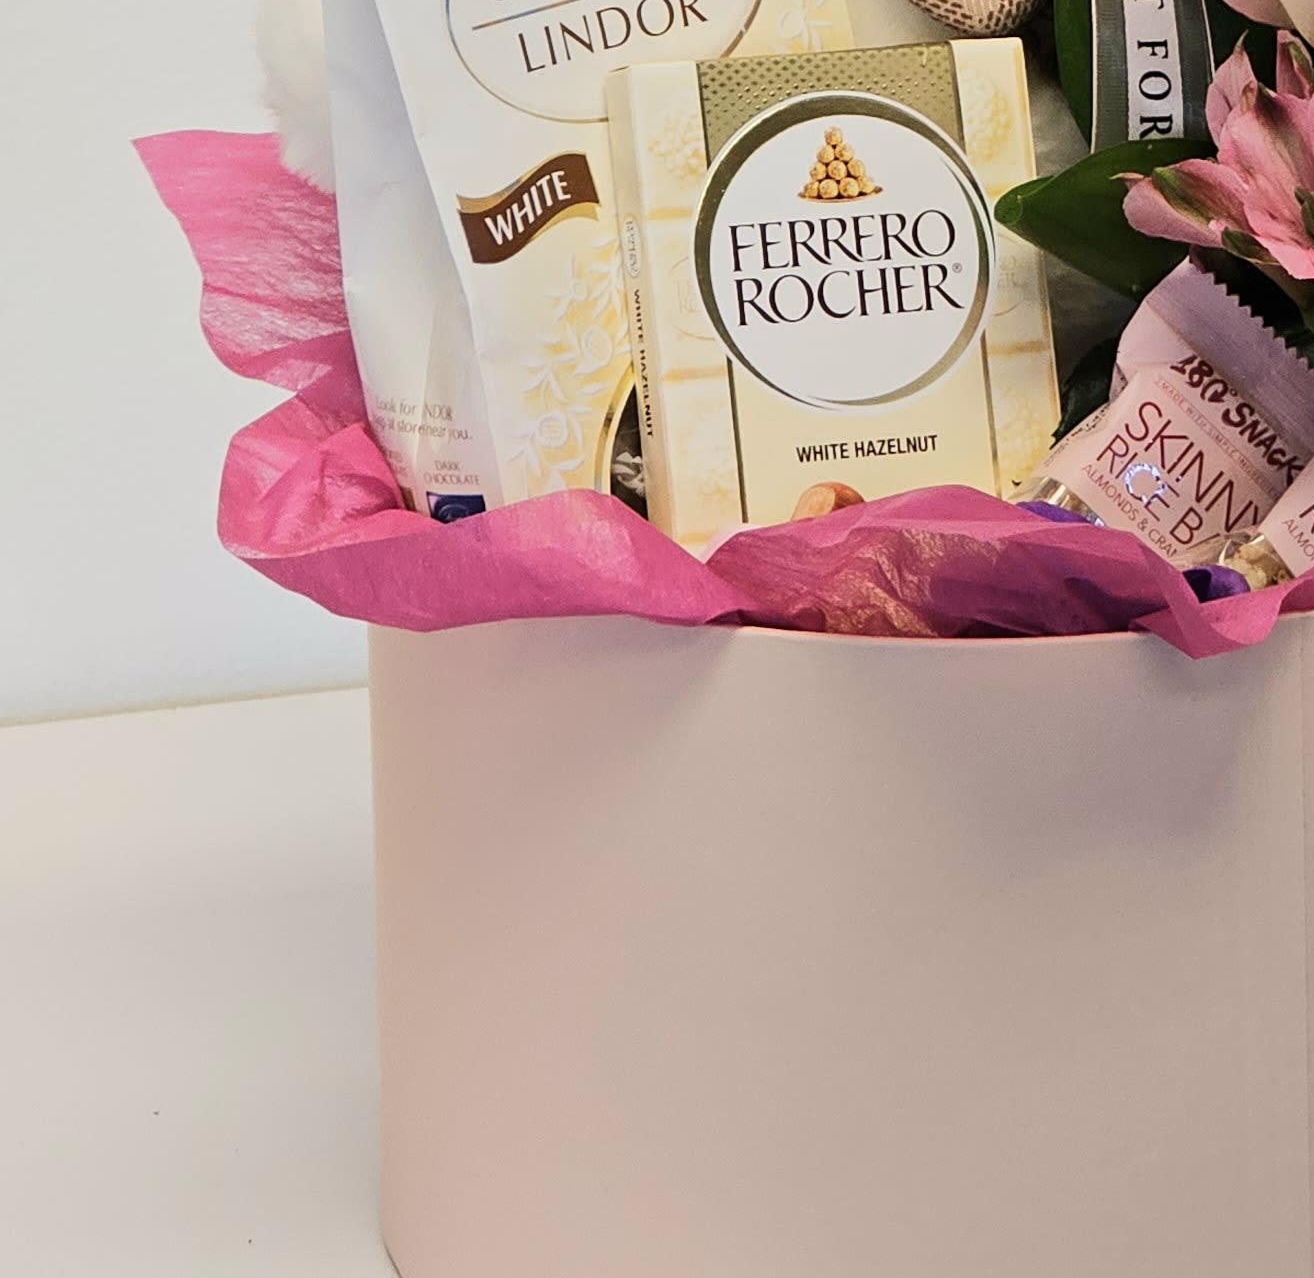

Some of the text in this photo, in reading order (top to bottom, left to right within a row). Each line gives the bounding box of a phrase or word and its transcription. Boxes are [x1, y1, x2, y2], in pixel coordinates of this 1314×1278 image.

[1136, 39, 1174, 139] FOR
[484, 170, 572, 246] WHITE
[728, 209, 956, 272] FERRERO
[796, 434, 938, 463] WHITE HAZELNUT
[1097, 434, 1180, 521] RICE
[1081, 463, 1139, 522] ALMONDS
